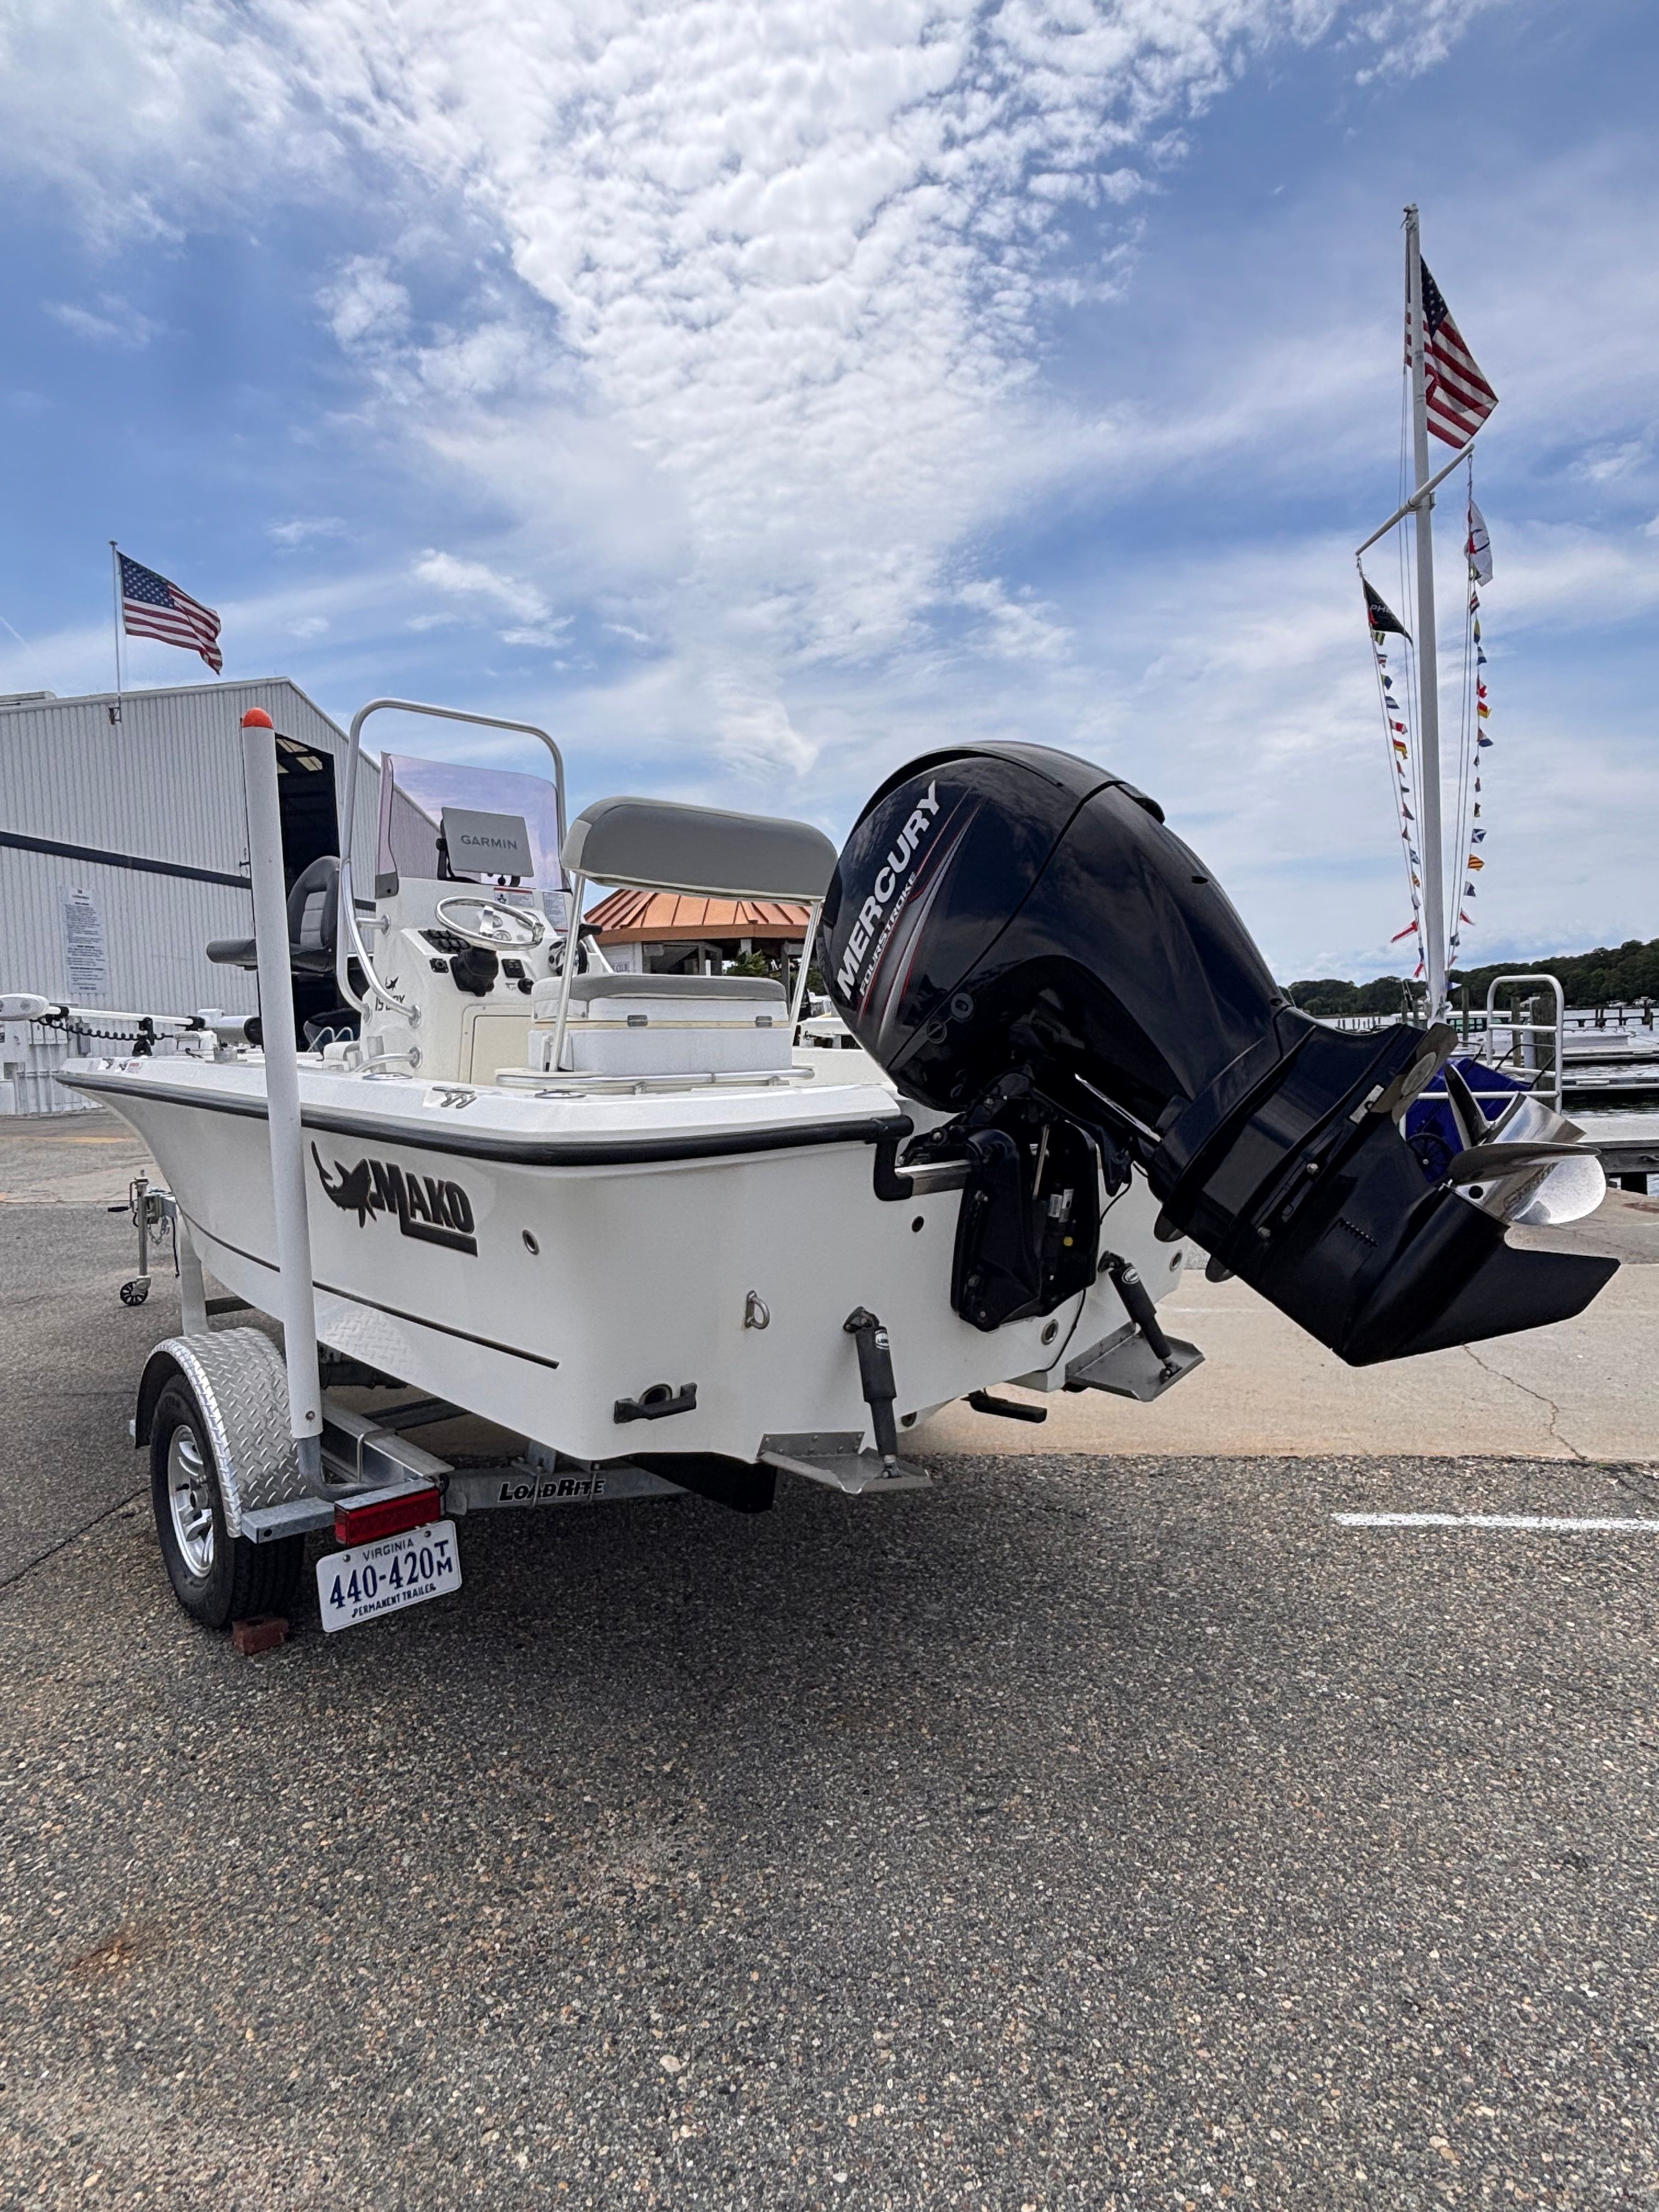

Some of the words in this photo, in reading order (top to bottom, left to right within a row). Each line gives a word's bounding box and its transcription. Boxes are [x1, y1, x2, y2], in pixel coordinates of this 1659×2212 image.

[460, 834, 517, 850] GARMIN
[837, 780, 939, 1001] MERCURY
[859, 872, 916, 997] FOURSTROKE
[368, 1159, 478, 1257] MAKO
[330, 1548, 434, 1610] 440-420
[363, 1538, 414, 1561] VIRGINIA
[351, 1594, 400, 1618] PERMANENT
[402, 1583, 436, 1601] TRAILER
